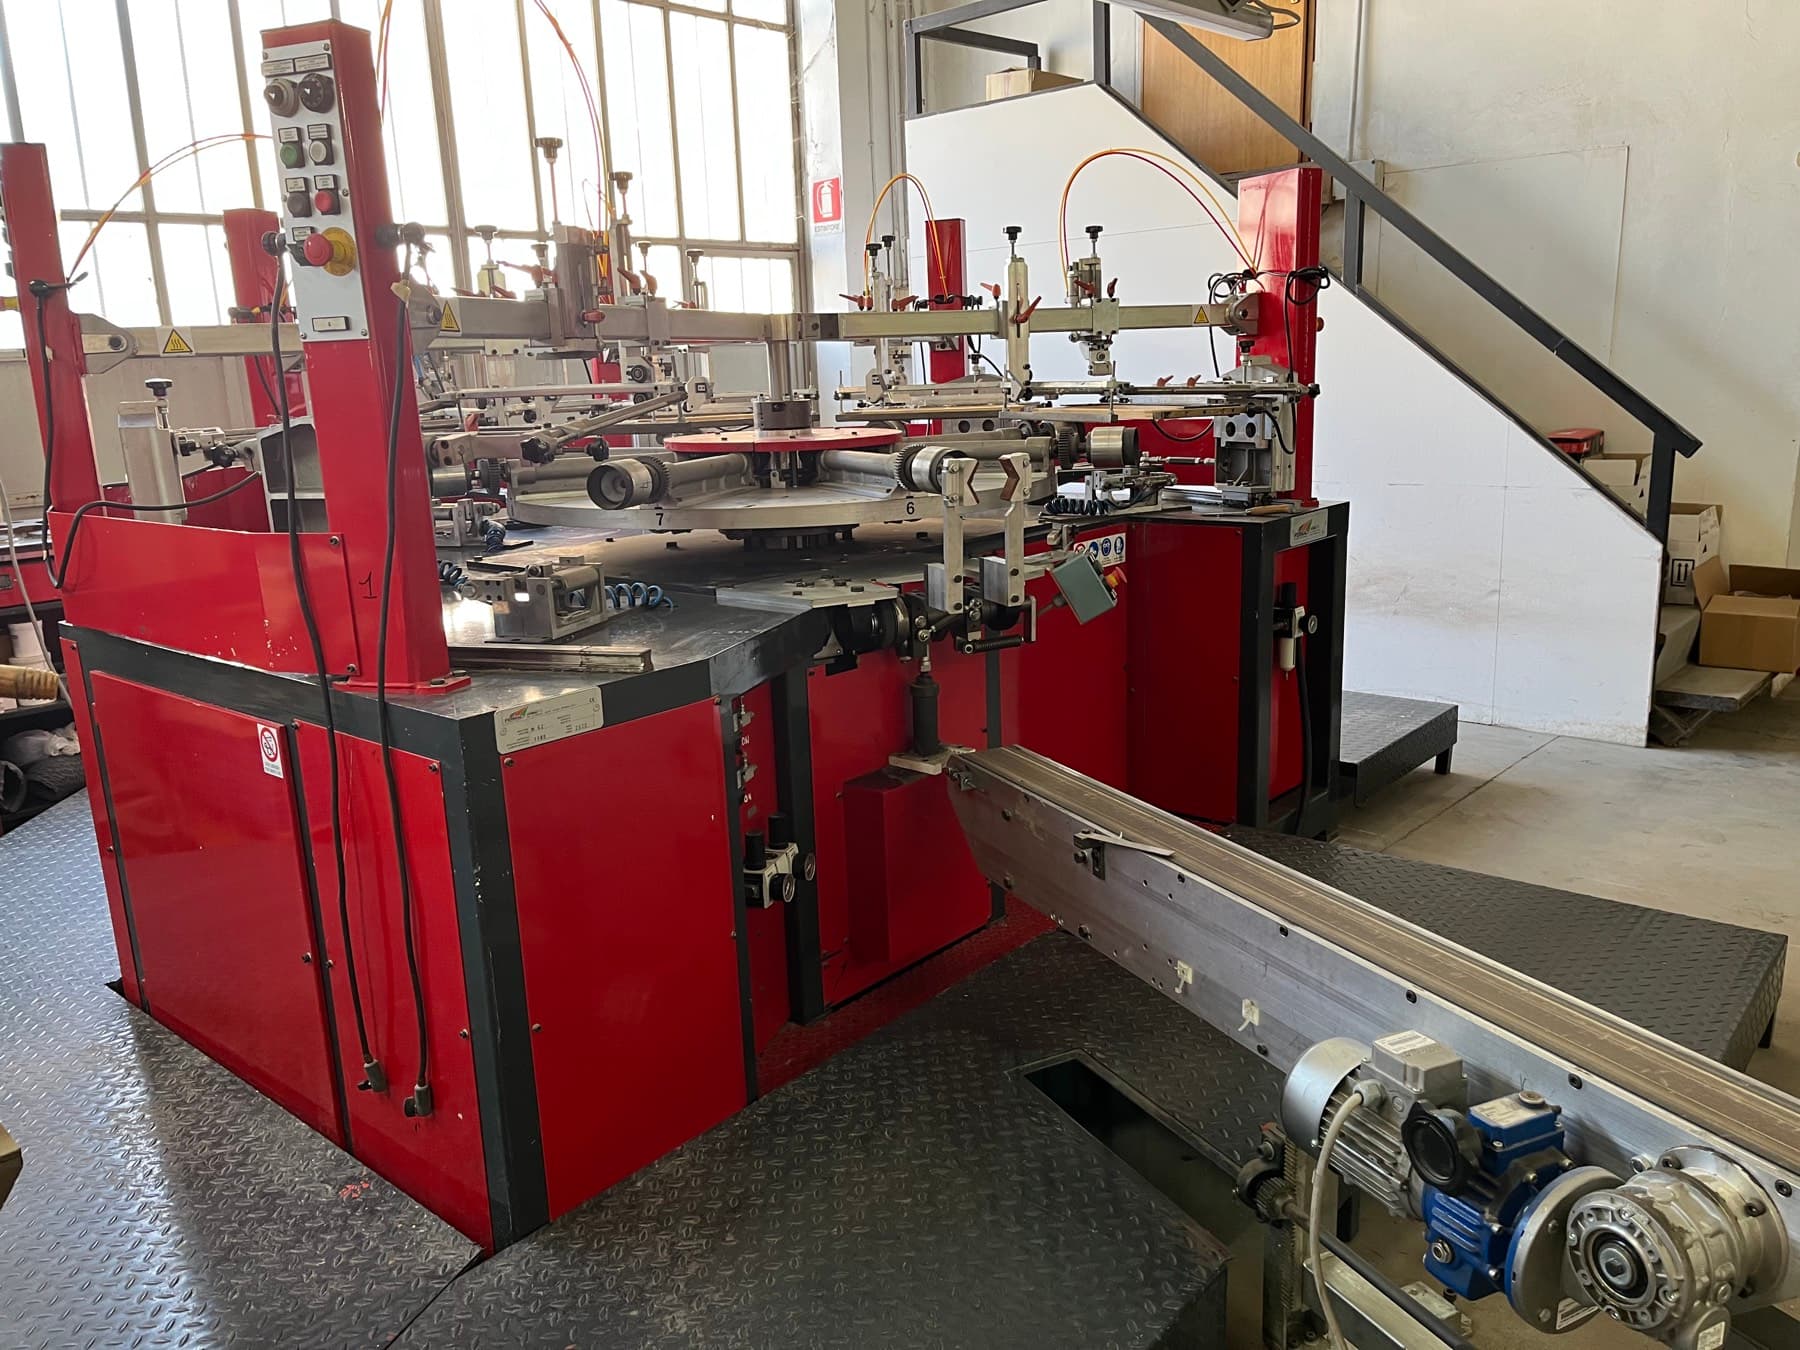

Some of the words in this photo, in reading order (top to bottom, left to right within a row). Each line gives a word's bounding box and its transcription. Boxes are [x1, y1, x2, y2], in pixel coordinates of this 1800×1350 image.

[906, 501, 915, 515] 6
[655, 512, 664, 526] 7
[358, 571, 378, 599] 1
